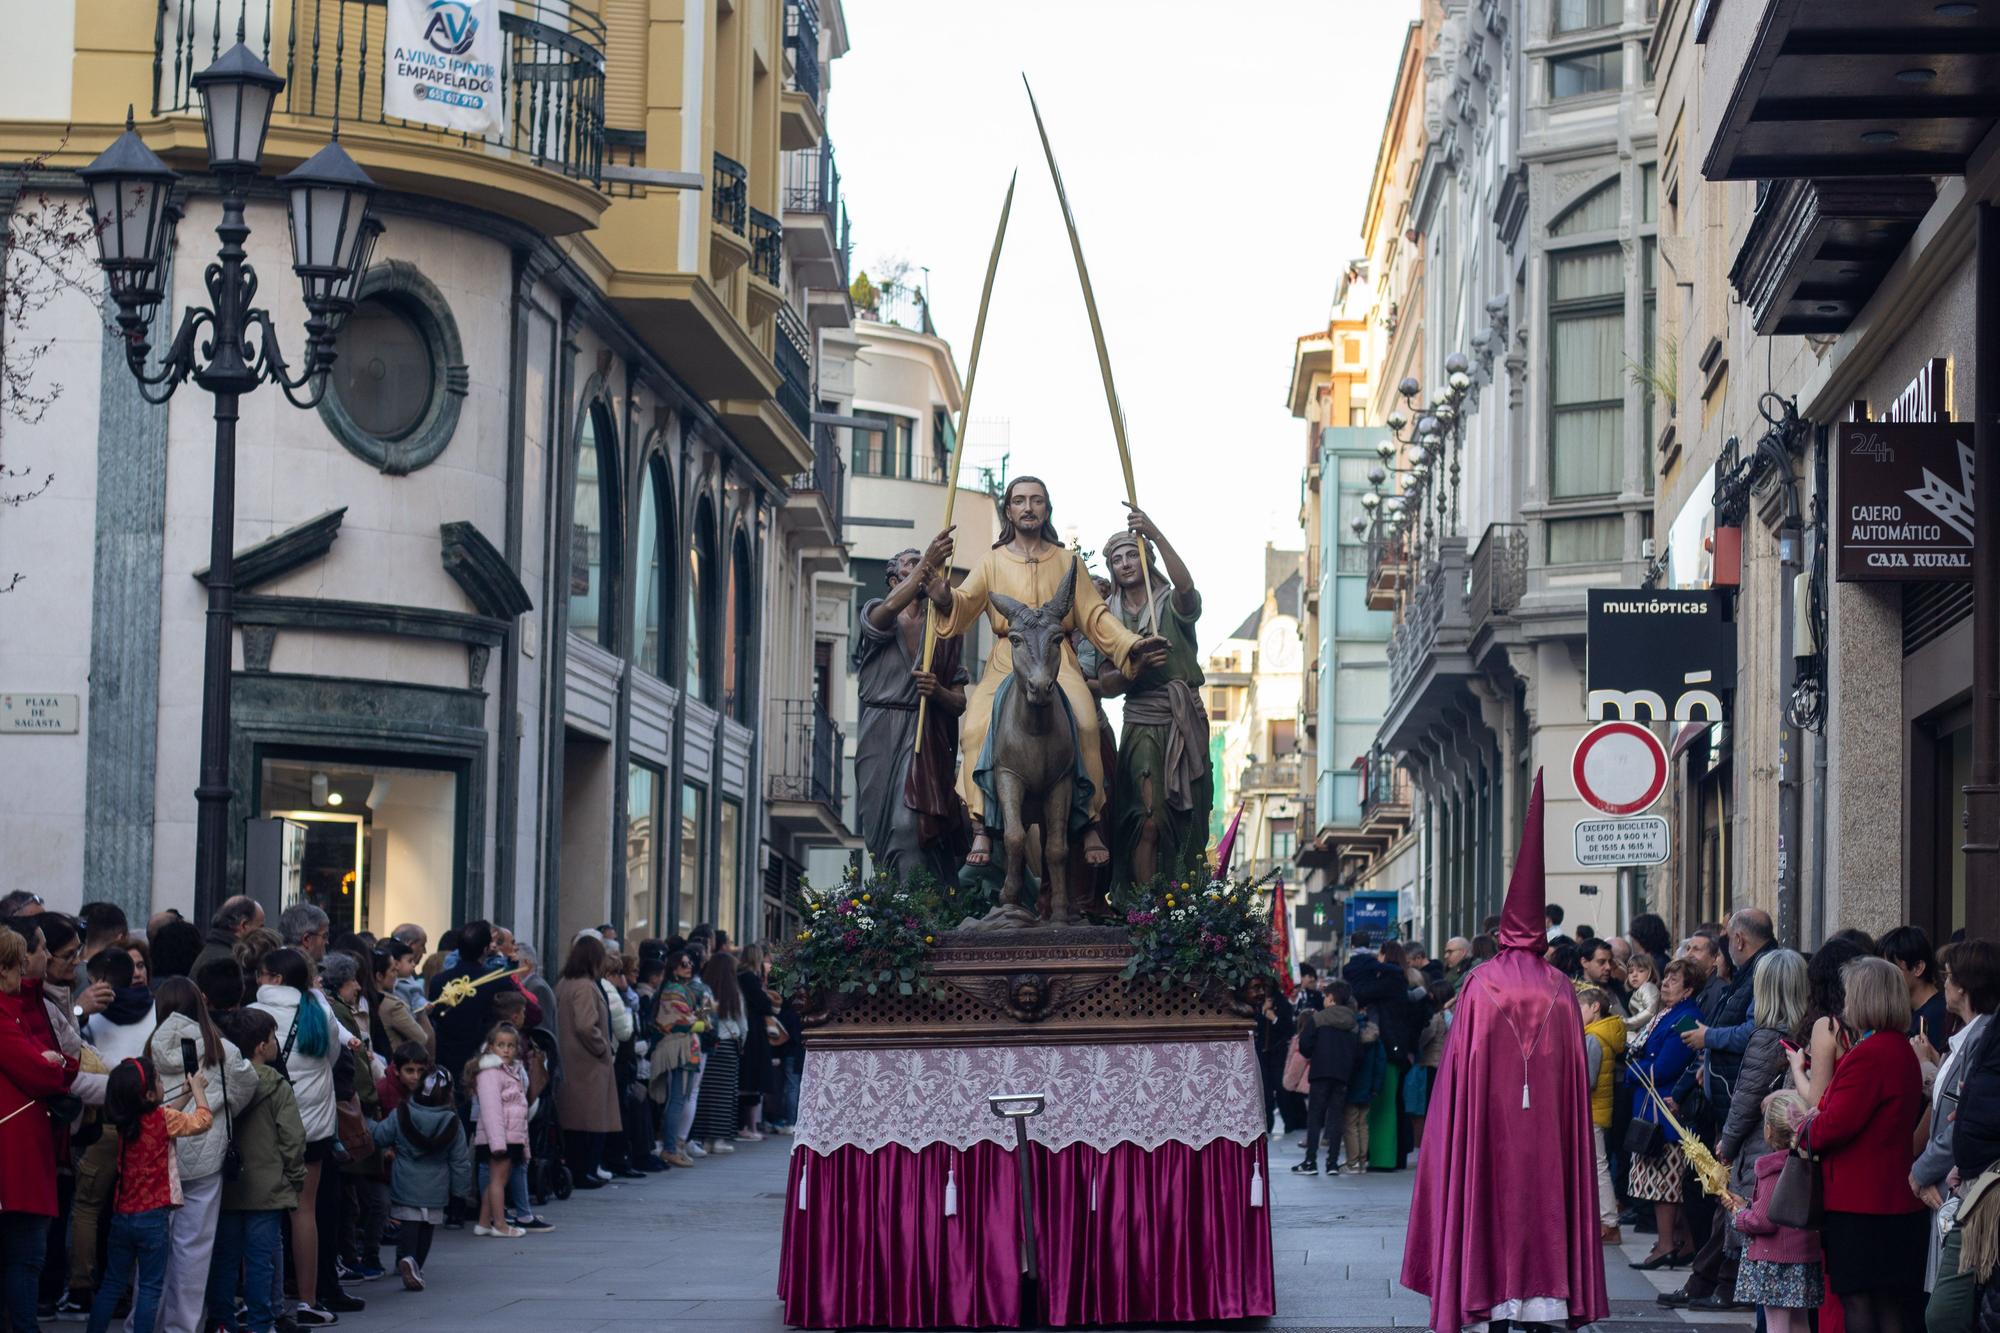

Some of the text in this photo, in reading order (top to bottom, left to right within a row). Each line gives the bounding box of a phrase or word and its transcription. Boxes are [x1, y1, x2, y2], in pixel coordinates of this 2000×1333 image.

[1851, 505, 1901, 521] CAJERO
[1851, 522, 1941, 540] AUTOMÁTICO
[1867, 553, 1971, 567] CAJA RURAL
[25, 698, 59, 707] PLAZA
[31, 709, 45, 717] DE
[15, 719, 61, 728] SAGASTA
[1583, 822, 1659, 832] EXCEPTO BICICLETAS
[1589, 844, 1599, 852] DE
[1583, 851, 1661, 861] PREFERENCIA PEATONAL
